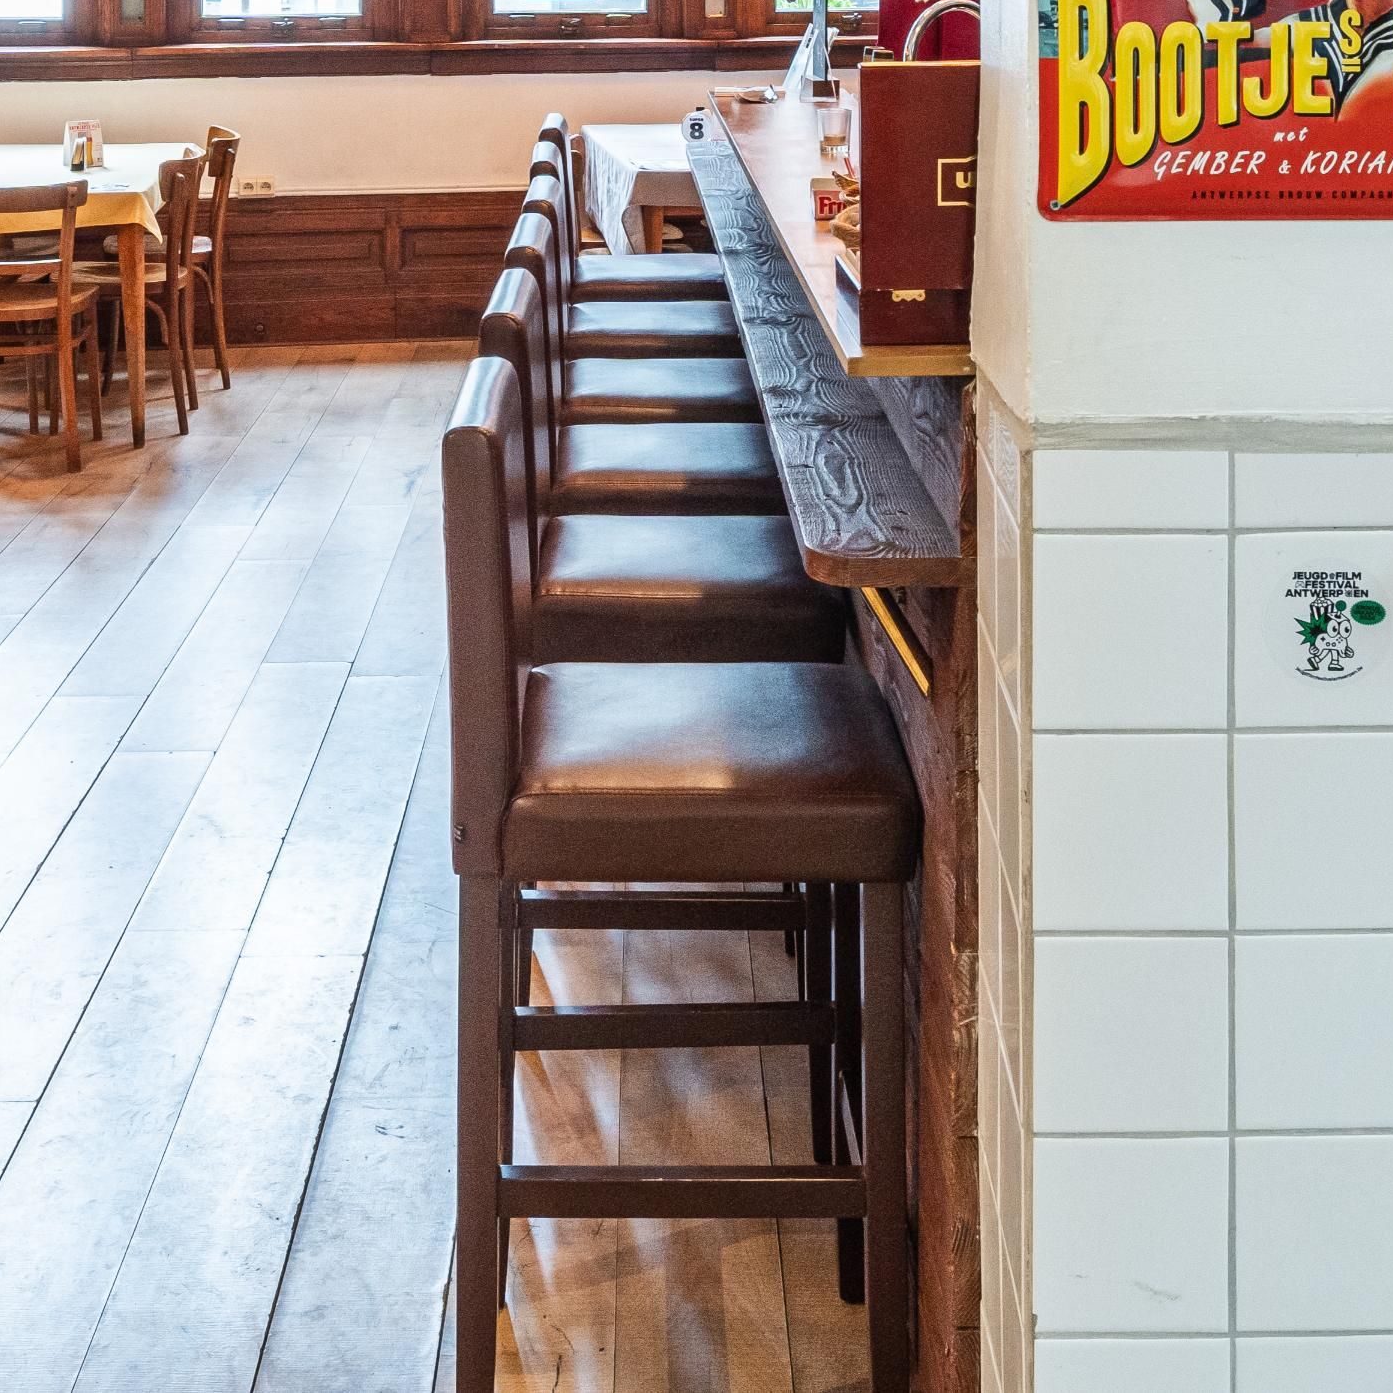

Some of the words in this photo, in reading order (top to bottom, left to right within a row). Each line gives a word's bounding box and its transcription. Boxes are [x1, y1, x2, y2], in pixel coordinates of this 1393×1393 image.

[689, 122, 705, 140] 8
[1273, 126, 1309, 143] met
[1153, 150, 1267, 181] GEMBER
[1278, 159, 1291, 174] &
[1191, 189, 1271, 200] ANTWERPSE
[1278, 189, 1325, 200] BROUW
[1304, 580, 1360, 589] FESTIVAL
